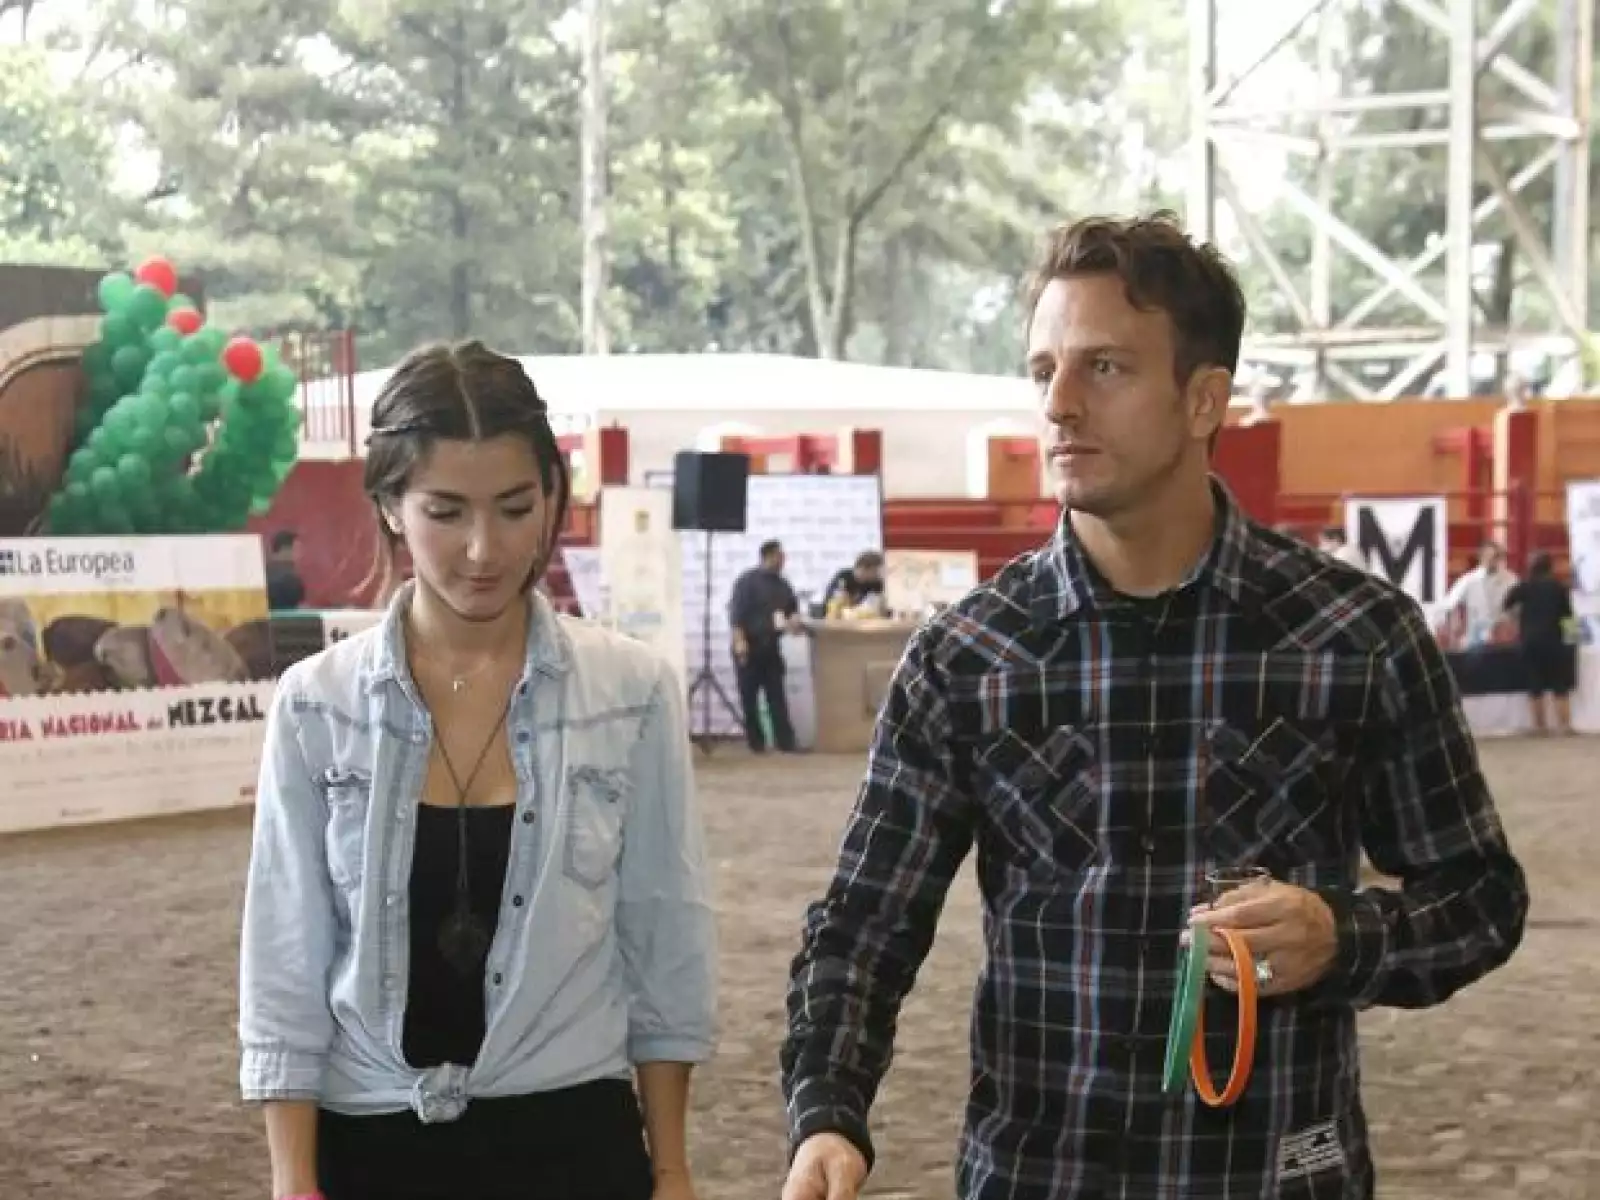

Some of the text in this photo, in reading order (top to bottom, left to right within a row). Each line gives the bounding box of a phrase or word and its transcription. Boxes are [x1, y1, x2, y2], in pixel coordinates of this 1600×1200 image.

[16, 549, 134, 579] La Europea
[1358, 506, 1435, 604] M
[41, 710, 141, 739] NACIONAL
[168, 695, 265, 728] MEZCAL
